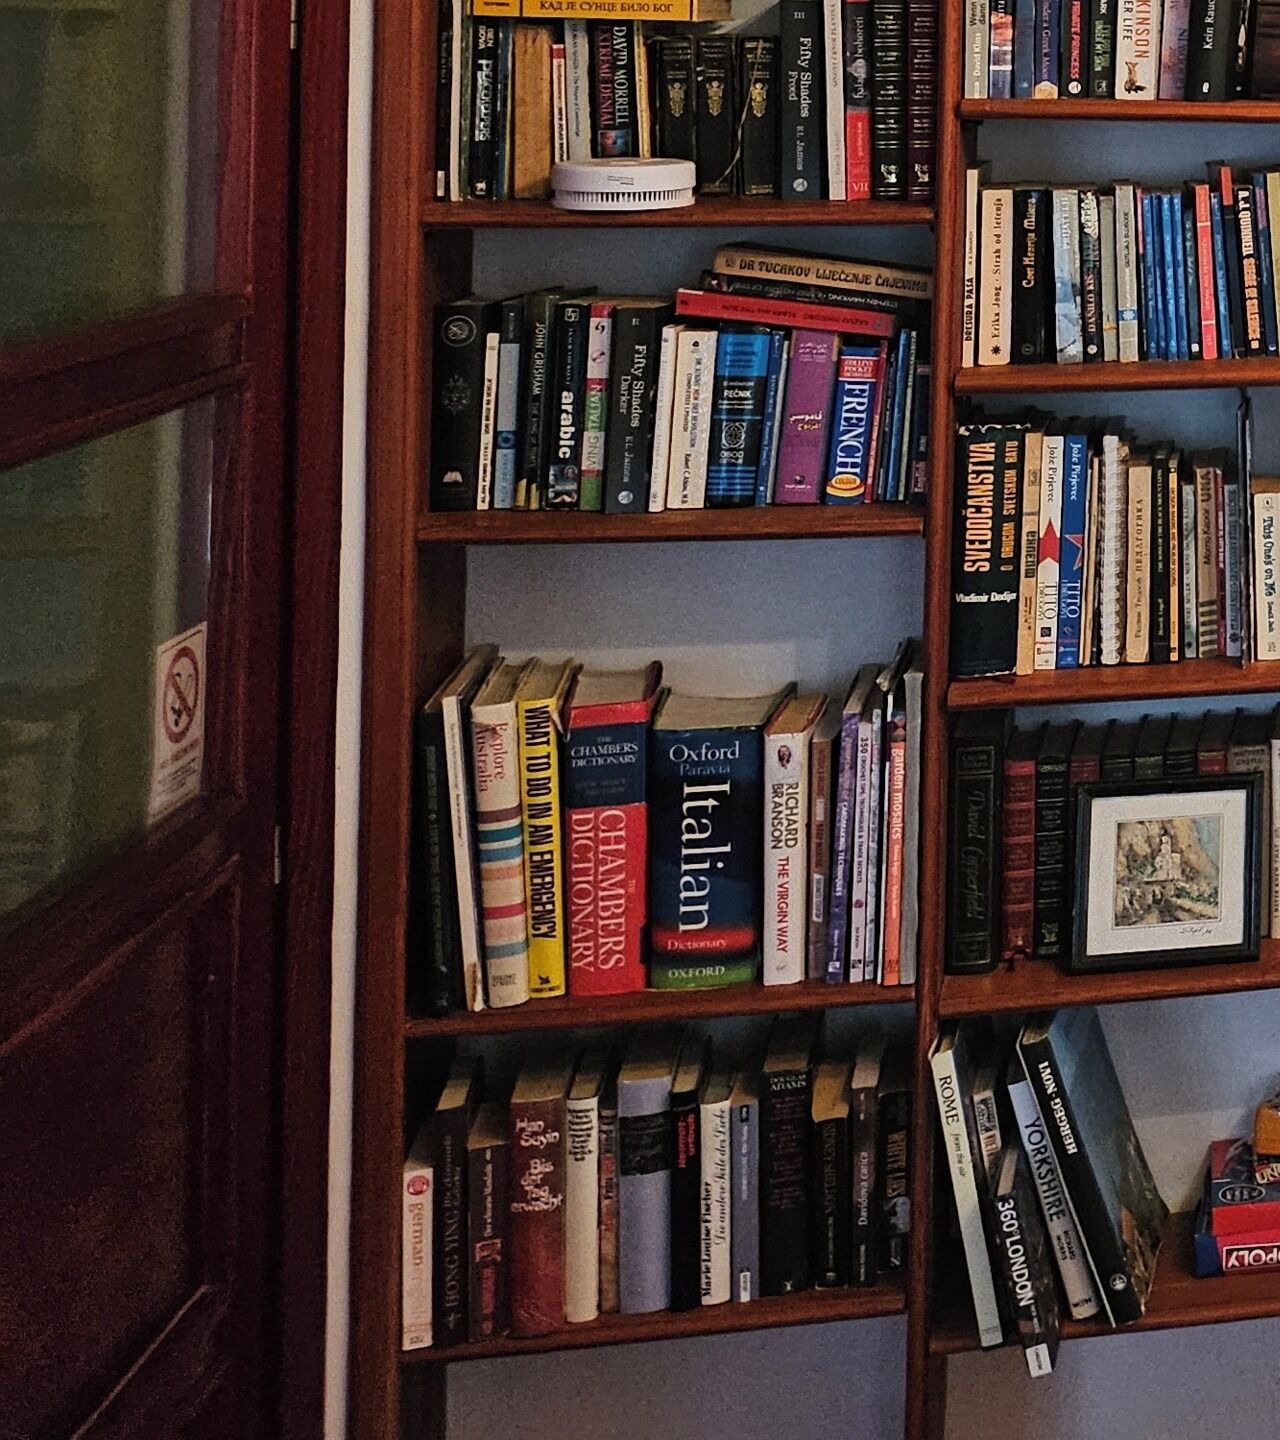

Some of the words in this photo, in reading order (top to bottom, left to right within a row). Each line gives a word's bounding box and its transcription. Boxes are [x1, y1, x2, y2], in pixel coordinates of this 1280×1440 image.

[969, 2, 978, 27] Wenn
[977, 3, 987, 25] dann
[1123, 17, 1133, 41] LIFE
[599, 26, 611, 79] EXTREME
[799, 37, 812, 66] Fifty
[1203, 27, 1214, 49] Kein
[789, 71, 799, 101] Freed
[799, 71, 812, 117] Shades
[600, 84, 613, 127] DENIAL
[993, 198, 1002, 228] letenja
[994, 233, 1001, 244] od
[993, 249, 1001, 275] Strah
[993, 285, 1002, 308] Jong
[535, 322, 545, 348] JOHN
[533, 352, 544, 395] GRISHAM
[631, 345, 646, 376] Fifty
[619, 376, 631, 414] Darker
[630, 381, 644, 427] Shades
[559, 391, 575, 458] arabic
[834, 382, 870, 474] FRENCH
[1047, 445, 1058, 469] Jože
[1070, 442, 1081, 467] Jože
[1047, 471, 1057, 503] Pirjevec
[1068, 469, 1080, 501] Pirjevec
[962, 441, 996, 572] SVEDOČANSTVA
[1045, 582, 1058, 620] TITO
[1067, 580, 1080, 619] TITO
[523, 705, 552, 746] WHAT
[474, 725, 491, 792] Australia
[491, 723, 508, 779] Explore
[527, 754, 552, 773] TO
[570, 742, 638, 756] CHAMBERS
[572, 753, 638, 768] DICTIONARY
[669, 742, 739, 762] Oxford
[889, 749, 905, 788] garden
[527, 777, 552, 795] DO
[529, 802, 553, 818] IN
[770, 783, 784, 850] BRANSON
[784, 782, 799, 848] RICHARD
[891, 792, 904, 839] mosaics
[529, 825, 553, 845] AN
[678, 780, 732, 933] Italian
[778, 857, 790, 880] THE
[529, 851, 557, 940] EMERGENCY
[571, 813, 594, 973] DICTIONARY
[597, 810, 625, 969] CHAMBERS
[776, 882, 789, 923] VIRGIN
[776, 926, 788, 953] WAY
[668, 965, 725, 978] OXFORD
[1023, 1118, 1066, 1222] YORKSHIRE
